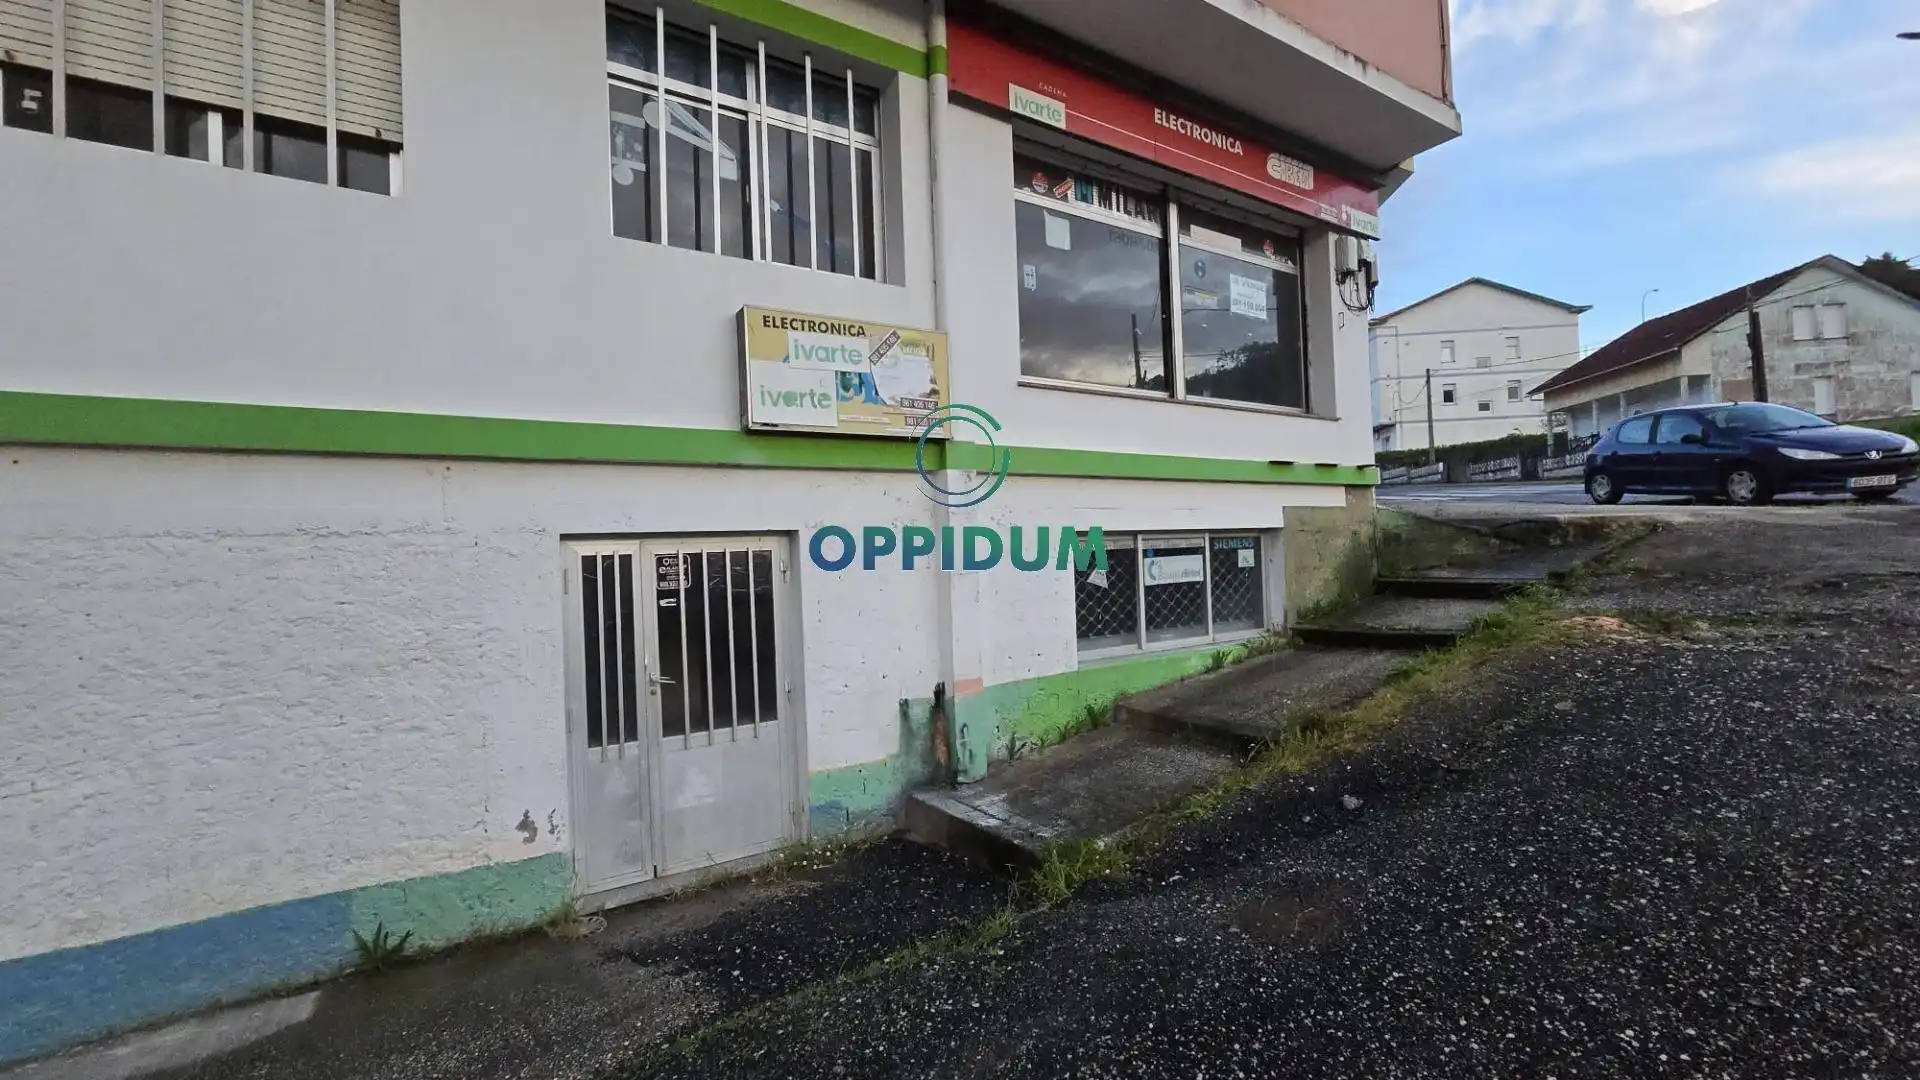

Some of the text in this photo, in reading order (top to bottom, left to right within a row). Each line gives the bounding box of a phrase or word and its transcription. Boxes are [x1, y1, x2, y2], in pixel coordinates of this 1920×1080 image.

[1154, 107, 1244, 156] ELECTRONICA
[762, 314, 867, 337] ELECTRONICA
[793, 339, 863, 366] ivarte
[760, 385, 832, 409] ivarte
[1214, 537, 1255, 550] SIEMENS
